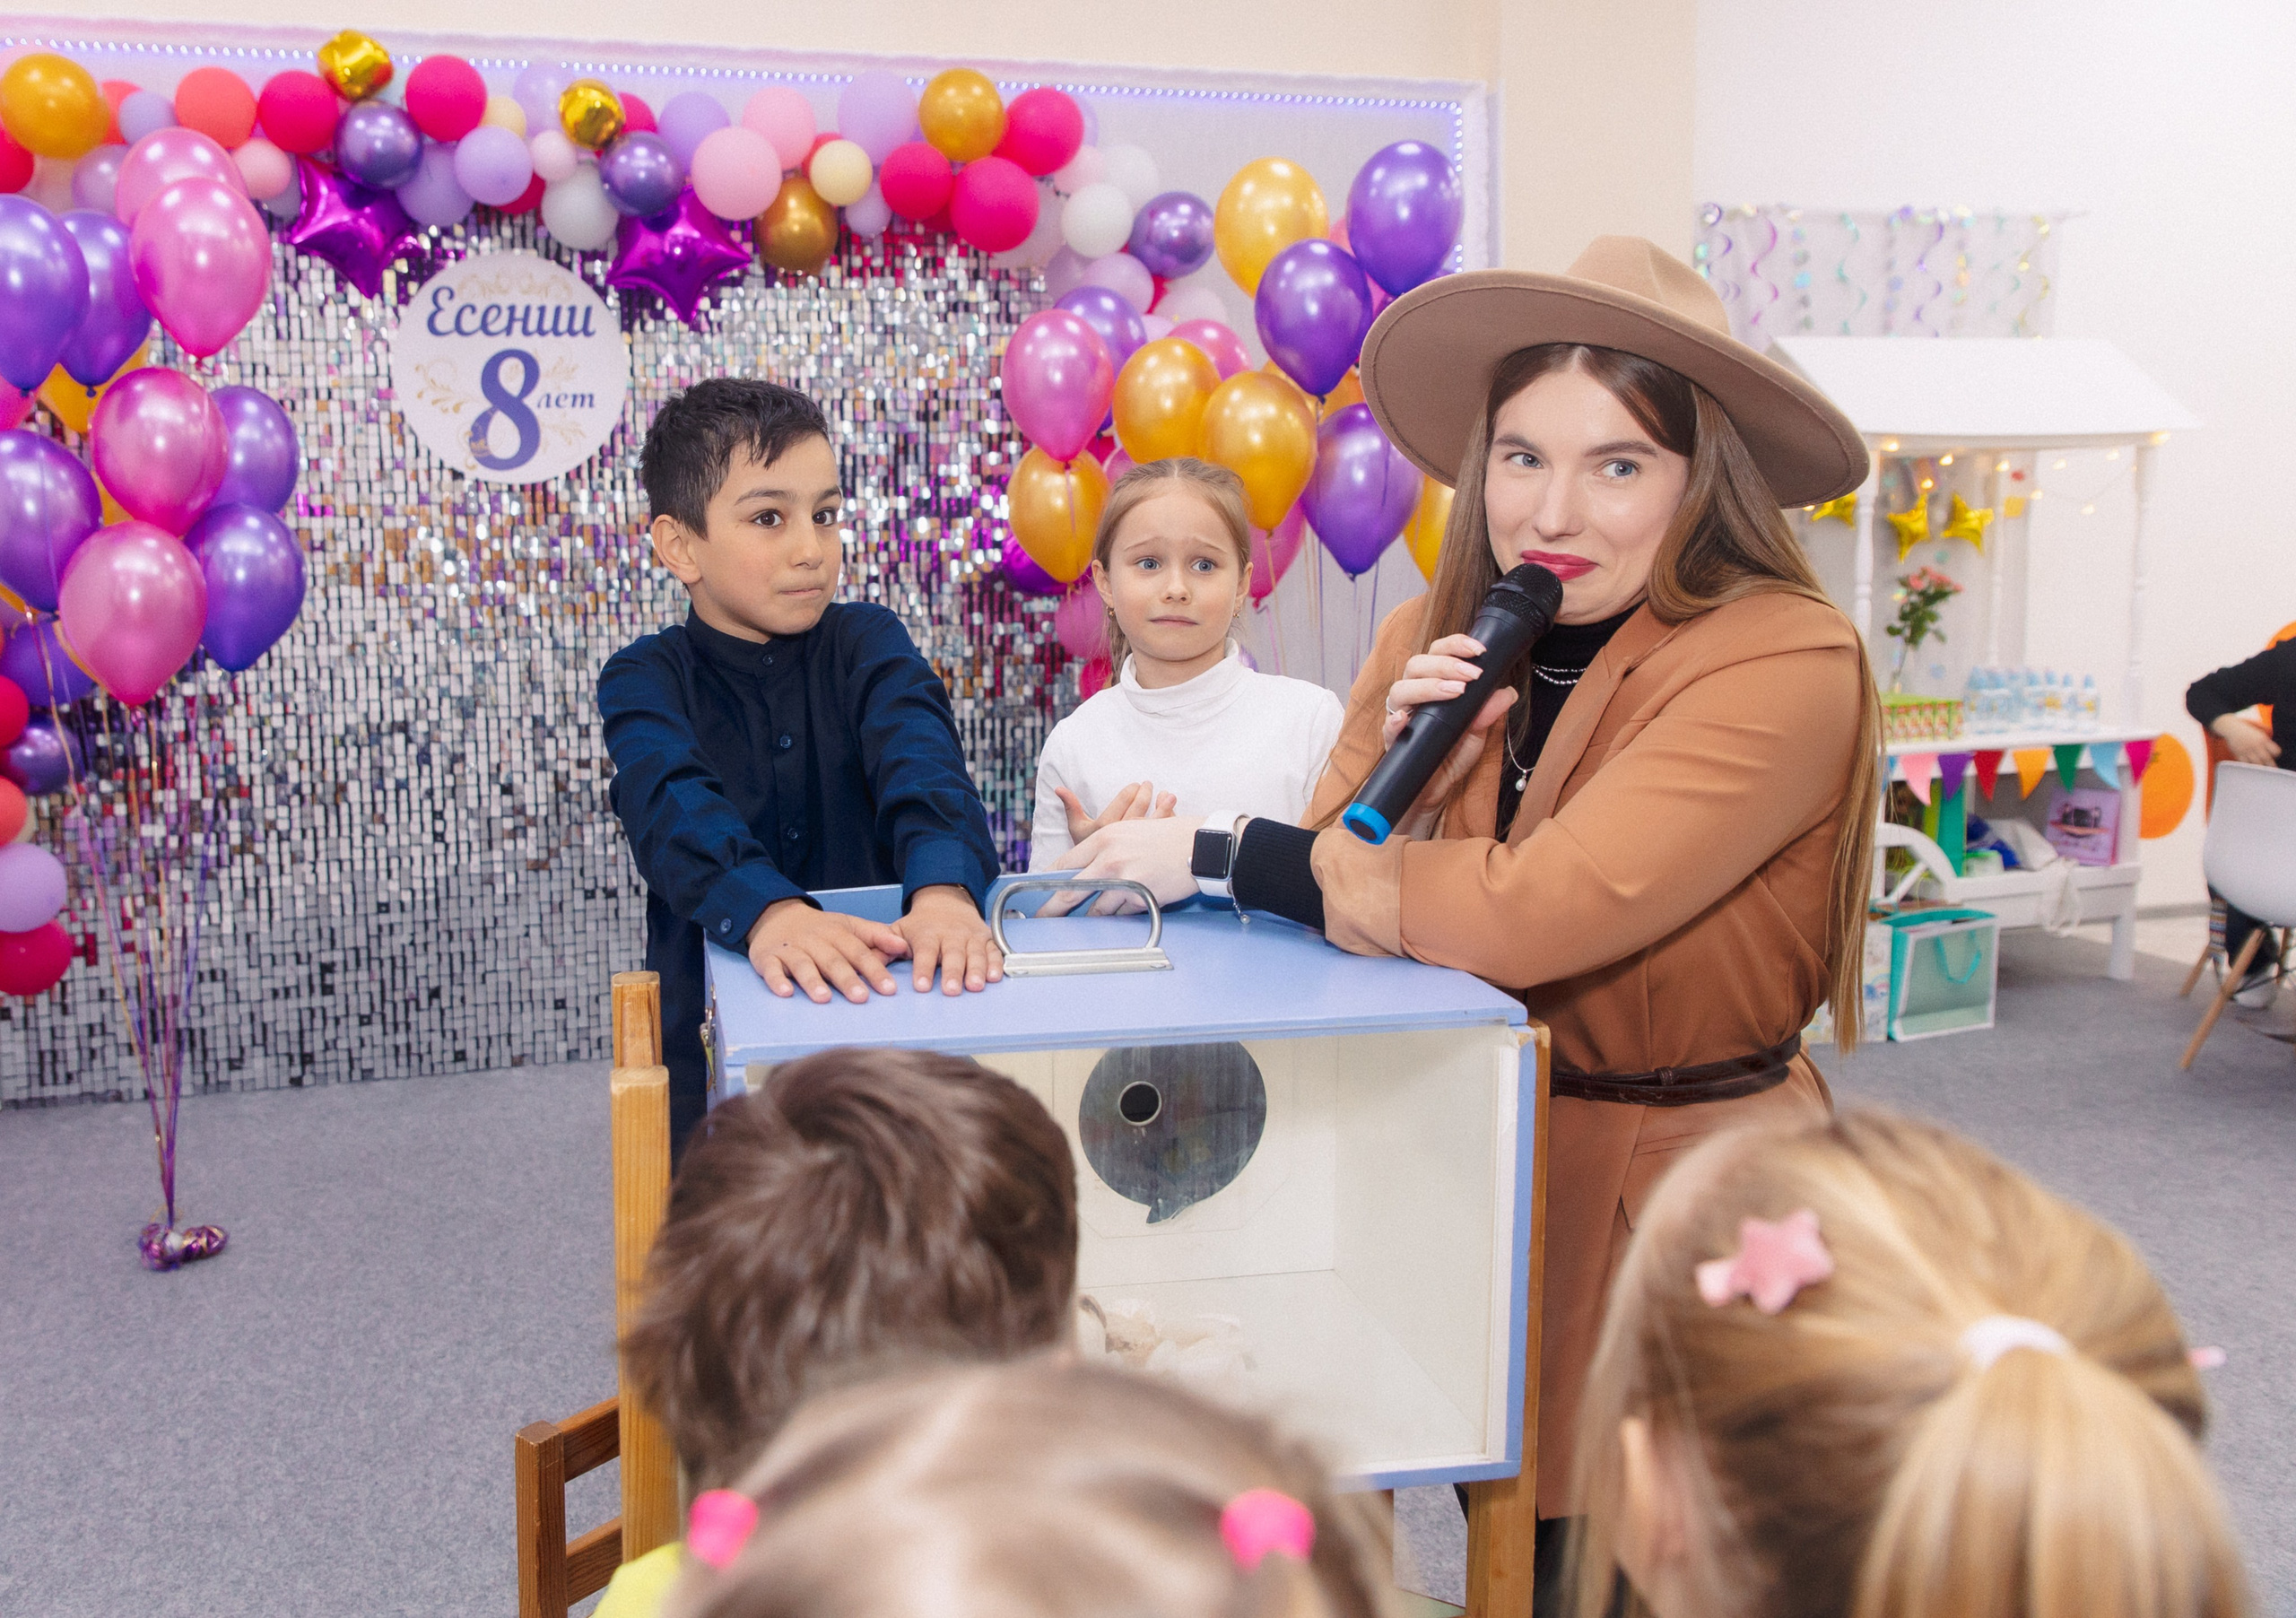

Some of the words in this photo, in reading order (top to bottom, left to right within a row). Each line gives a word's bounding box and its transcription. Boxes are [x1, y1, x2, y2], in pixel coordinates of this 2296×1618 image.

[427, 285, 596, 337] Есении
[468, 348, 541, 471] 8
[537, 392, 596, 409] лет
